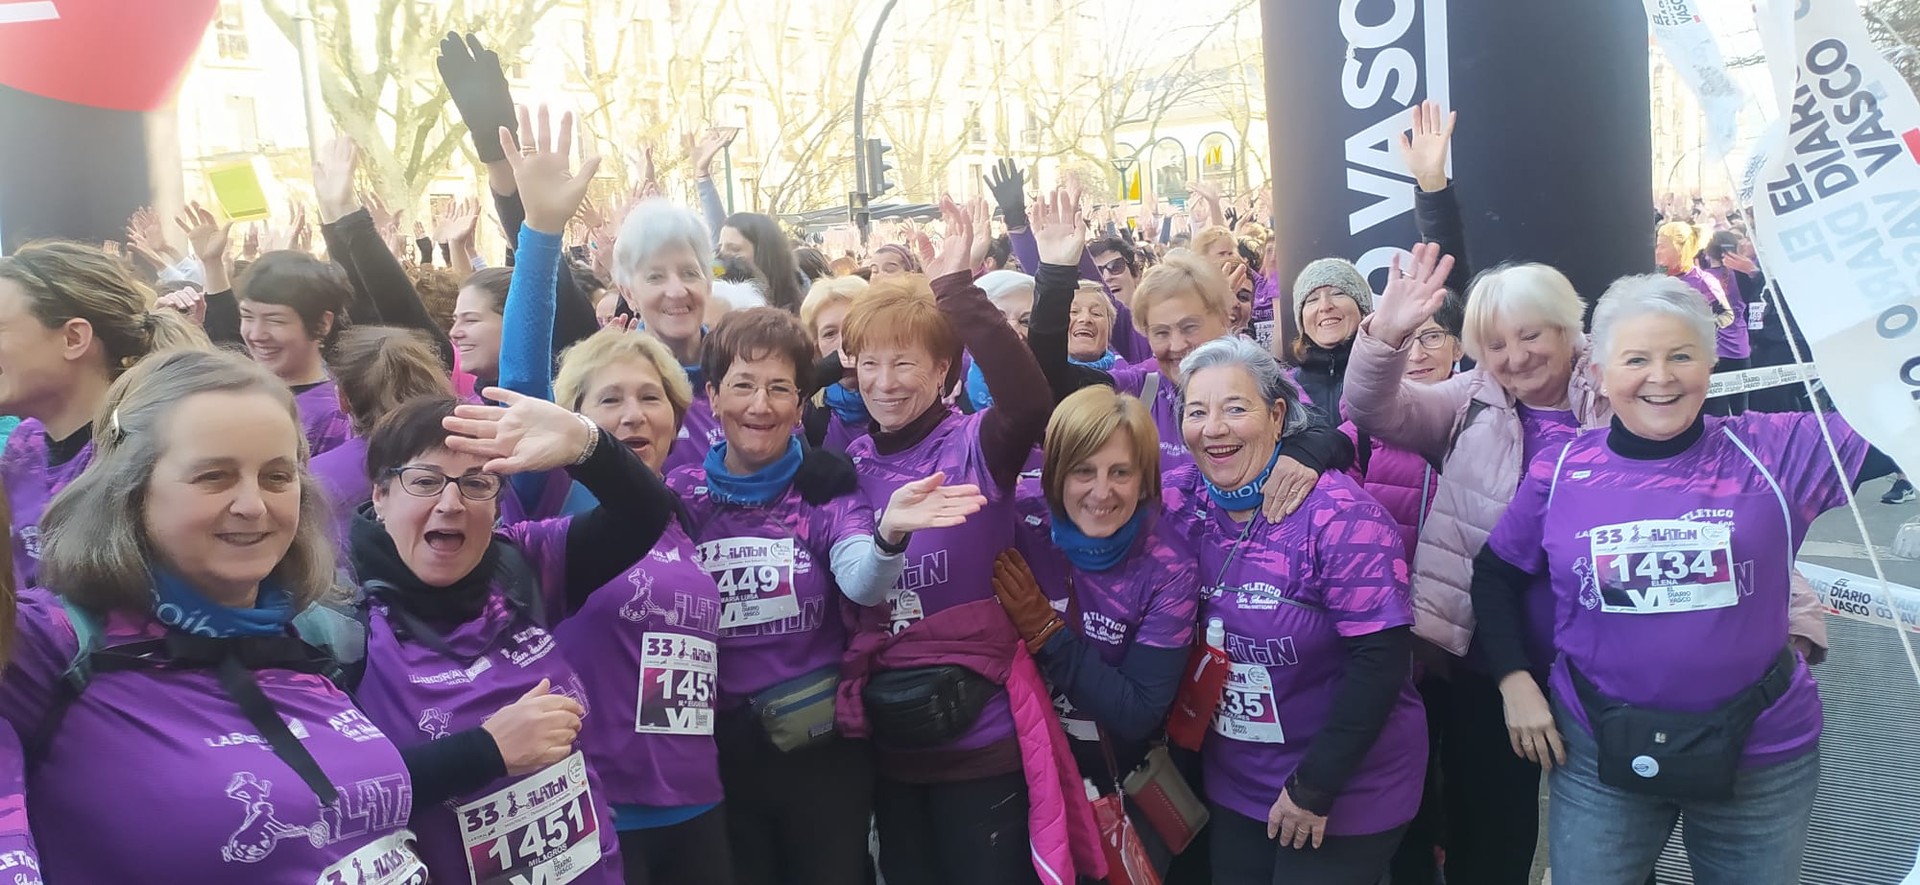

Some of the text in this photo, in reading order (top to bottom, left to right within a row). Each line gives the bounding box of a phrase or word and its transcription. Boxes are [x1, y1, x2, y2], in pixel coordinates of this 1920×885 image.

[1806, 38, 1903, 178] VASCO
[1789, 64, 1860, 199] DIARI
[1767, 162, 1814, 216] EL
[1610, 550, 1718, 583] 1434
[1238, 582, 1282, 598] TLETICO
[1651, 578, 1679, 587] ELENA
[1829, 585, 1872, 605] DIARIO
[1829, 598, 1870, 617] VASCO
[488, 793, 585, 871] 1451
[527, 842, 568, 868] MILAGROS
